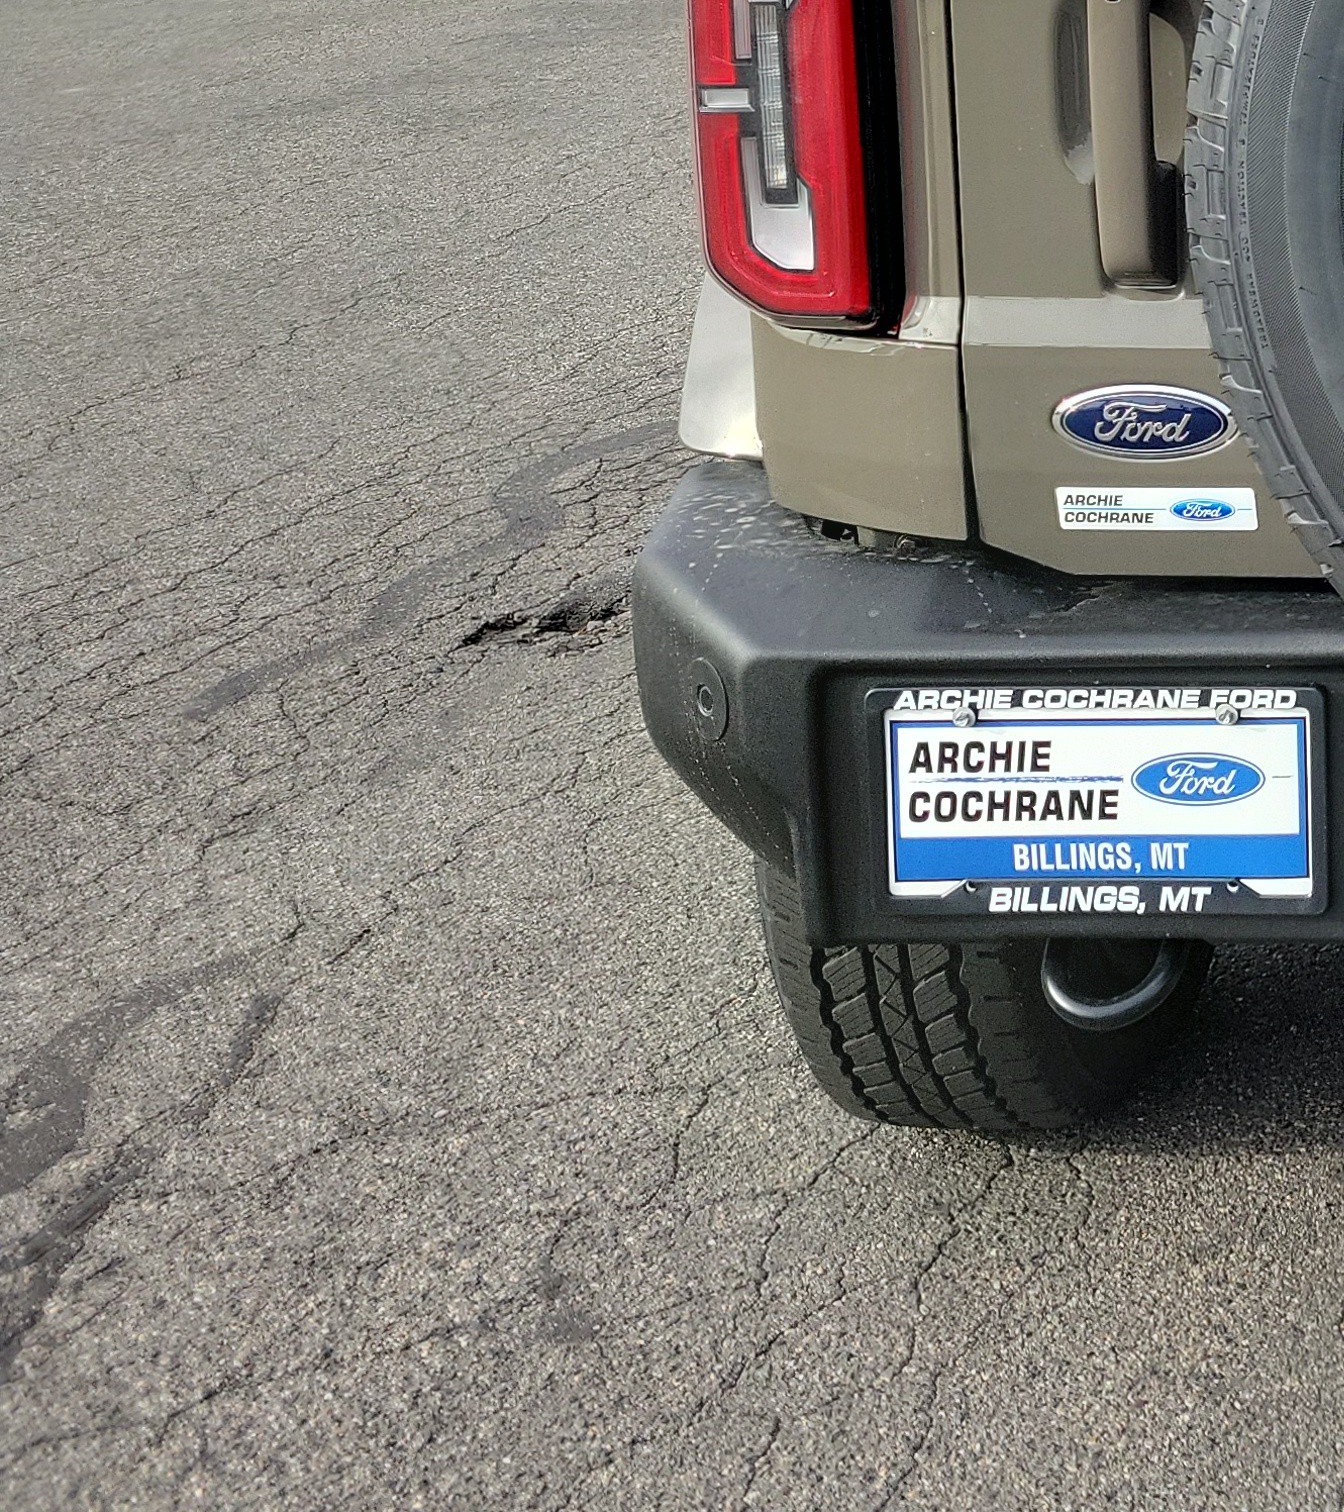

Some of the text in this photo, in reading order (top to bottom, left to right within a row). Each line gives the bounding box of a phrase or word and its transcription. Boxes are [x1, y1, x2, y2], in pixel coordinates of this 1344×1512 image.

[1094, 401, 1192, 442] Ford
[1063, 494, 1123, 506] ARCHIE
[1183, 500, 1222, 519] Ford
[1064, 512, 1154, 524] COCHRANE
[894, 689, 1298, 710] ARCHIE COCHRANE FORD
[909, 740, 1052, 774] ARCHIE
[1159, 758, 1237, 798] Ford
[908, 788, 1120, 823] COCHRANE
[1013, 842, 1190, 874] BILLINGS, MT
[988, 885, 1213, 916] BILLINGS, MT
